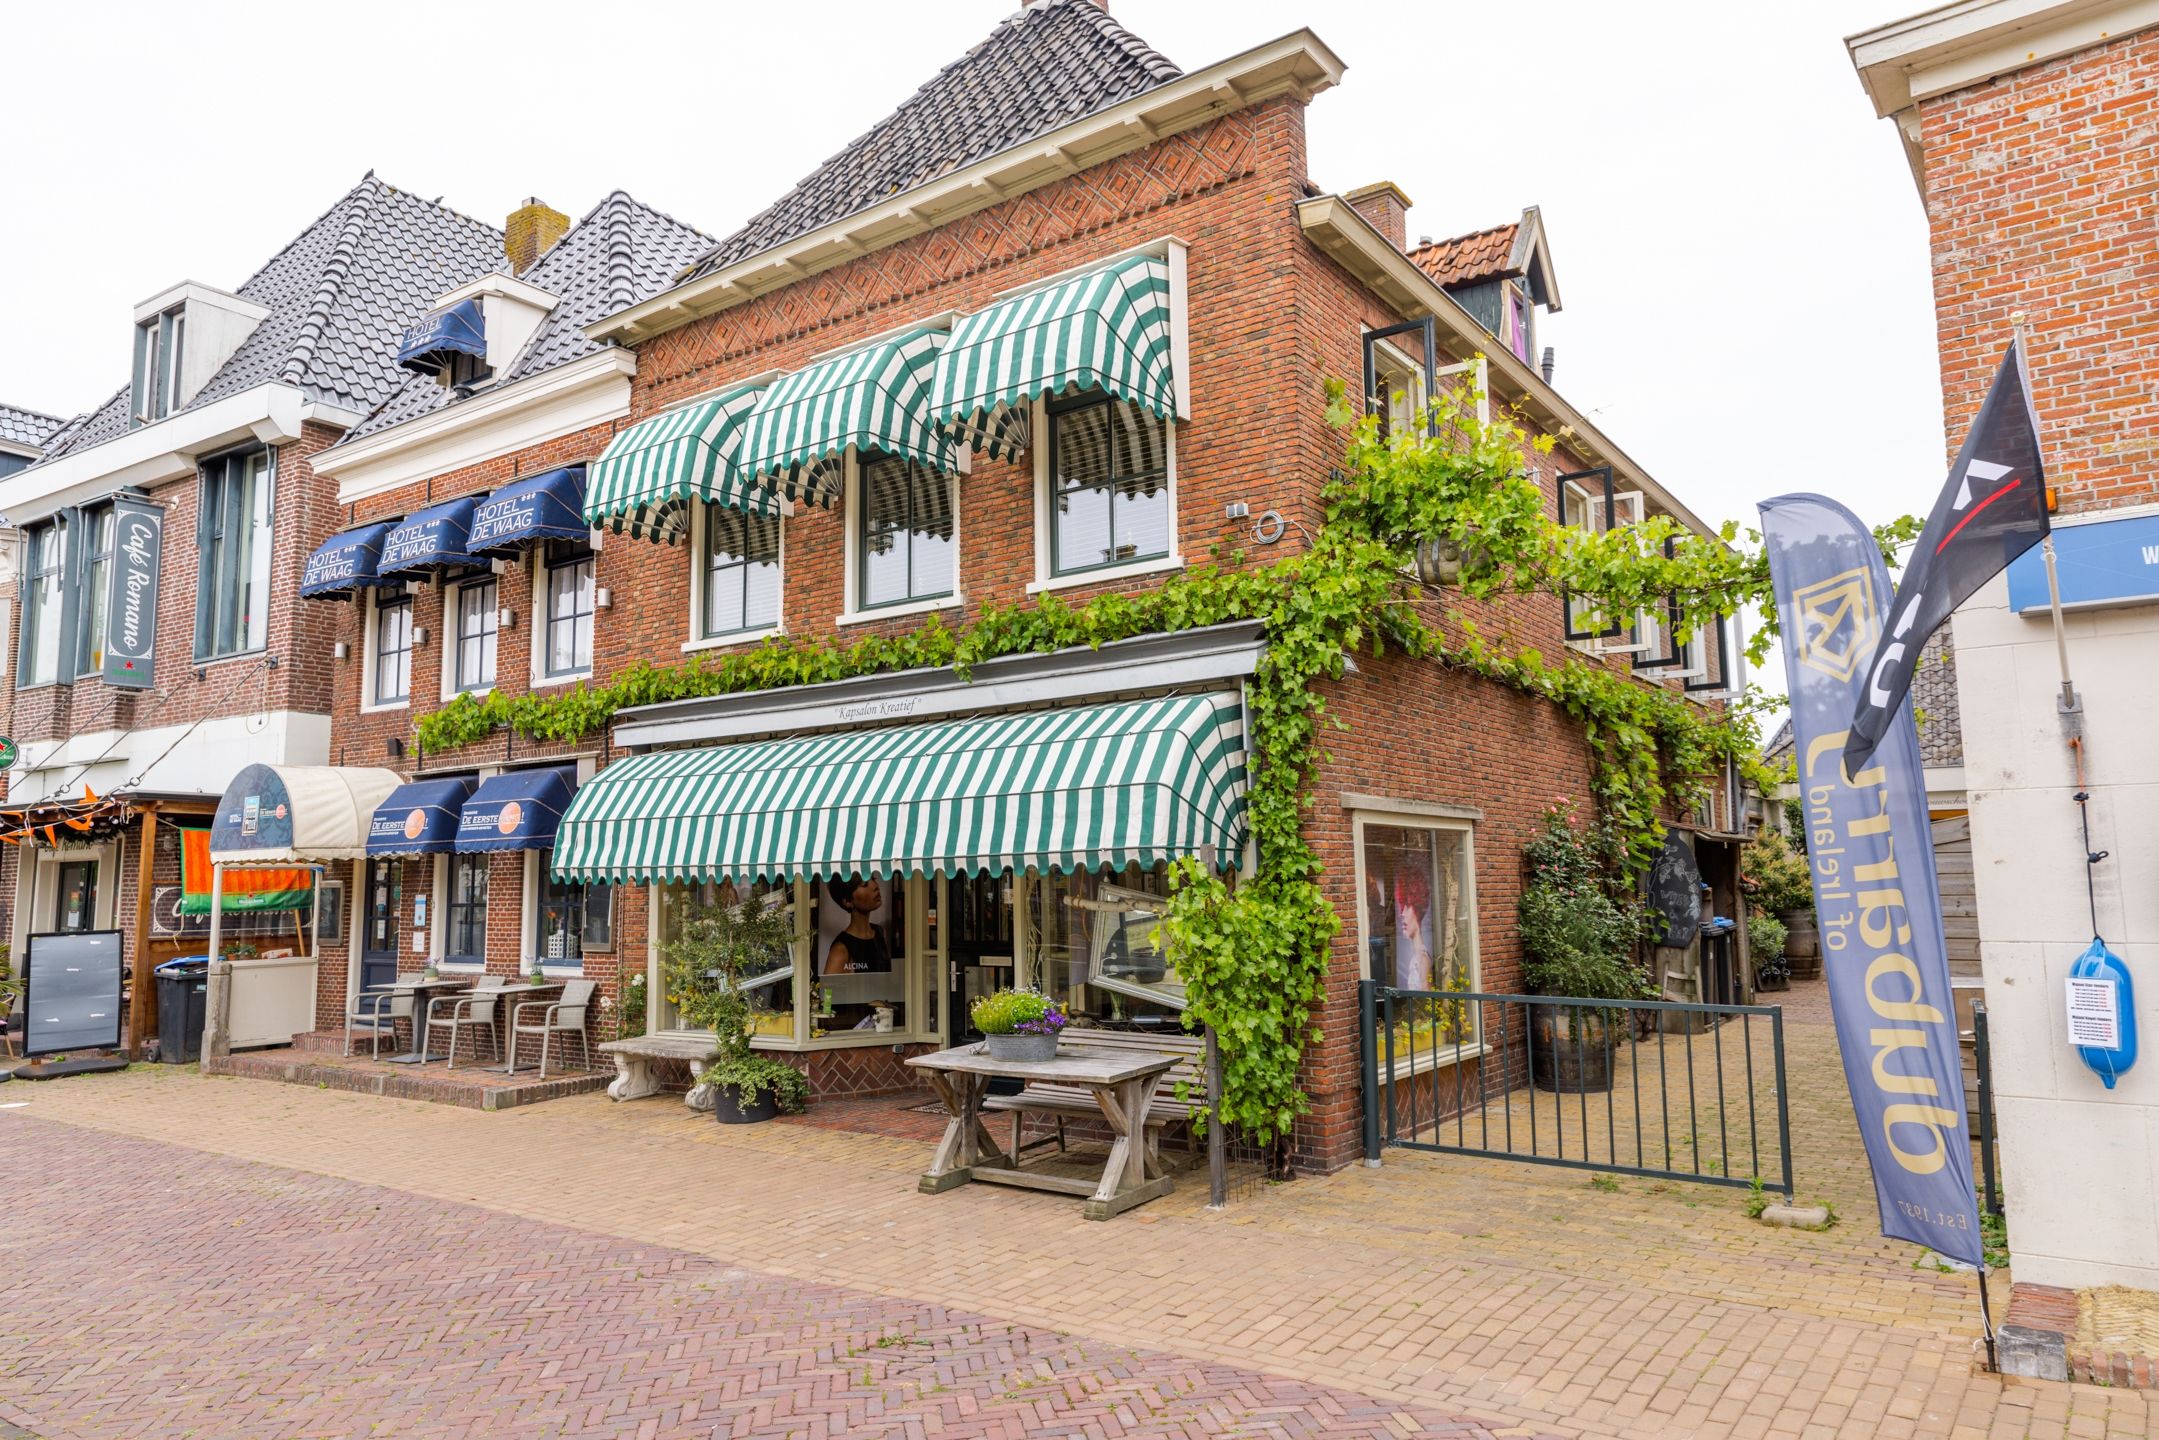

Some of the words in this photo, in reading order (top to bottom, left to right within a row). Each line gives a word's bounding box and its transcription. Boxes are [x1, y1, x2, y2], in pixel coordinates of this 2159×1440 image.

[407, 317, 441, 339] HOTEL
[476, 499, 520, 523] HOTEL
[386, 525, 425, 547] HOTEL
[472, 523, 491, 541] DE
[493, 512, 533, 535] WAAG
[122, 523, 153, 568] Café
[382, 547, 400, 564] DE
[401, 539, 437, 559] WAAG
[307, 549, 342, 569] HOTEL
[303, 570, 320, 586] DE
[320, 563, 353, 582] WAAG
[123, 568, 150, 651] Romano
[843, 962, 869, 970] ALCINA
